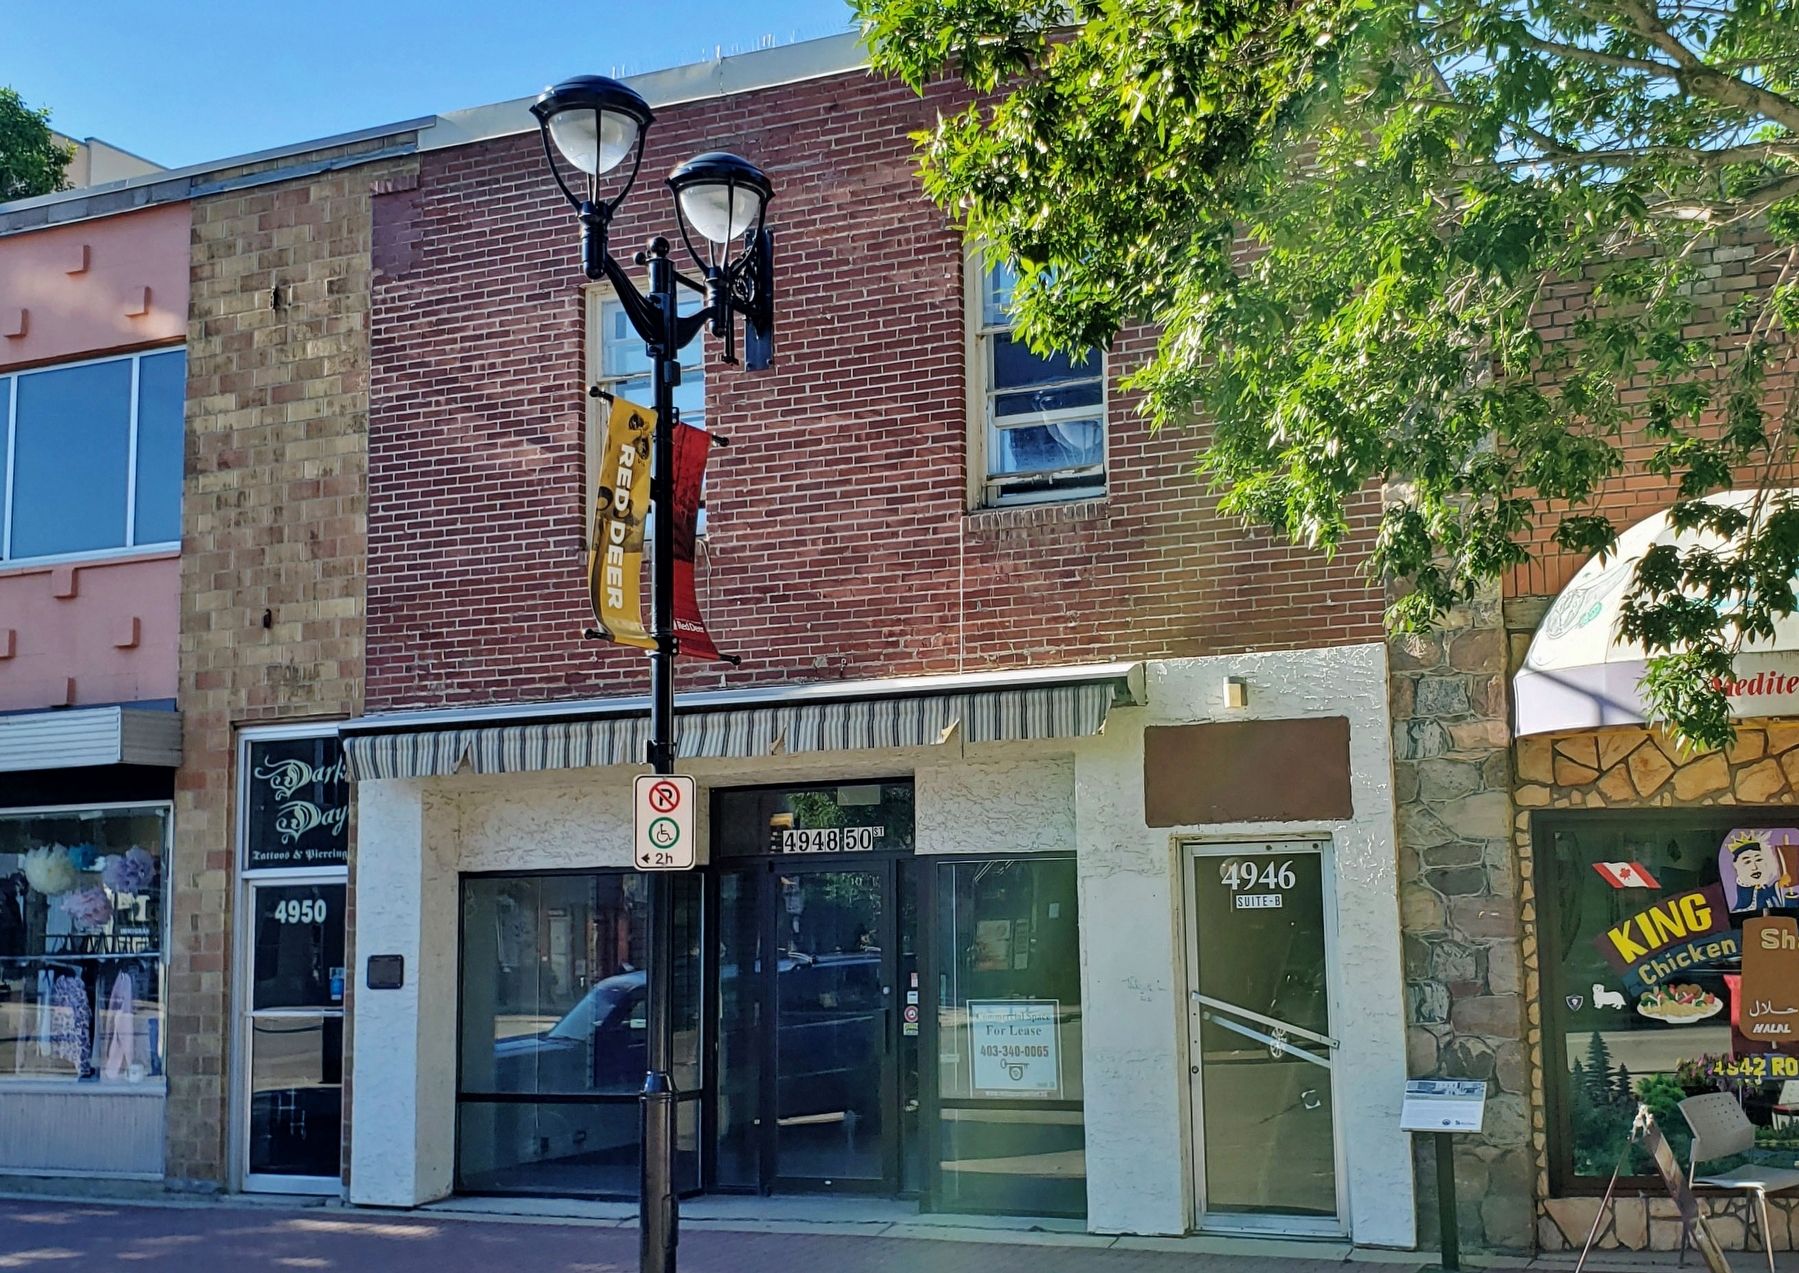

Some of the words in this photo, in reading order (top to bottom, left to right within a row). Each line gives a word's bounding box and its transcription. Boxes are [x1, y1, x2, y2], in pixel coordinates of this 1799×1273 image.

[614, 443, 635, 512] RED
[607, 520, 627, 610] DEER
[676, 620, 690, 631] Red
[276, 800, 350, 844] Day
[784, 830, 838, 852] 4948
[252, 850, 290, 860] Tattoos
[293, 849, 303, 859] &
[655, 852, 673, 865] 2h
[1221, 860, 1296, 891] 4946
[274, 899, 327, 924] 4950
[1237, 895, 1281, 907] SUITE-B
[1607, 892, 1713, 964] KING
[1761, 928, 1799, 950] Sh
[1637, 938, 1736, 984] Chicken
[1749, 1000, 1799, 1017] حلال
[986, 1024, 1006, 1036] For
[1009, 1024, 1042, 1036] Lease
